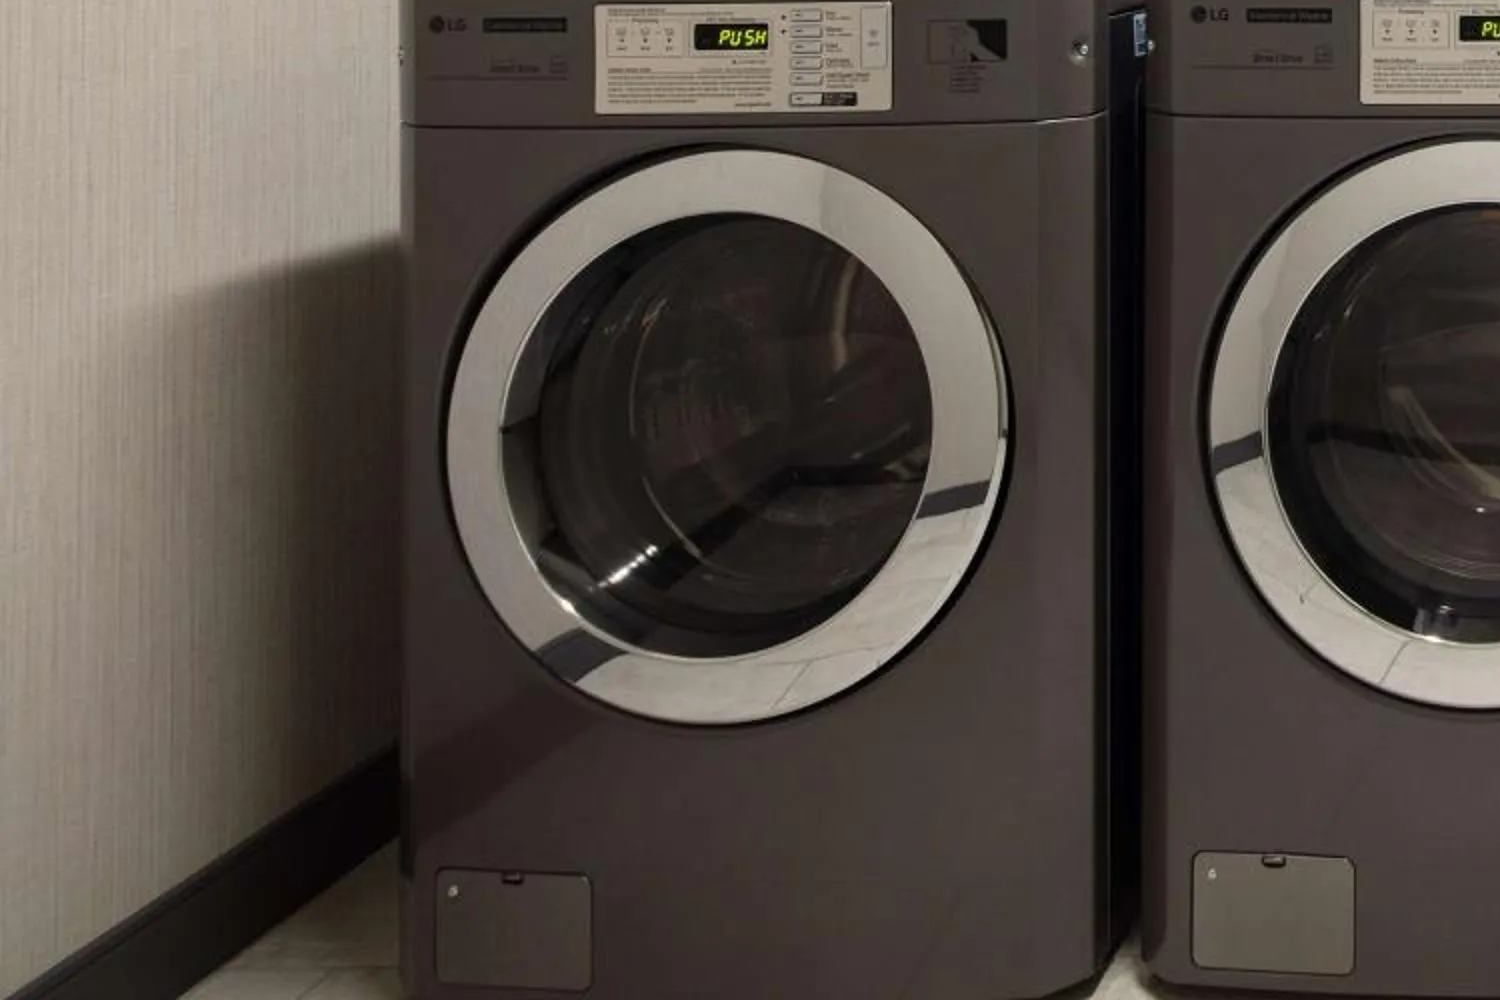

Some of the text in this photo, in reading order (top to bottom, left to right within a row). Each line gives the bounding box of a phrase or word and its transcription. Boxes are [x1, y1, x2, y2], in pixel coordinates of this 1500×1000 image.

[1210, 8, 1229, 22] LG
[447, 18, 467, 32] LG
[718, 29, 768, 46] PUSH
